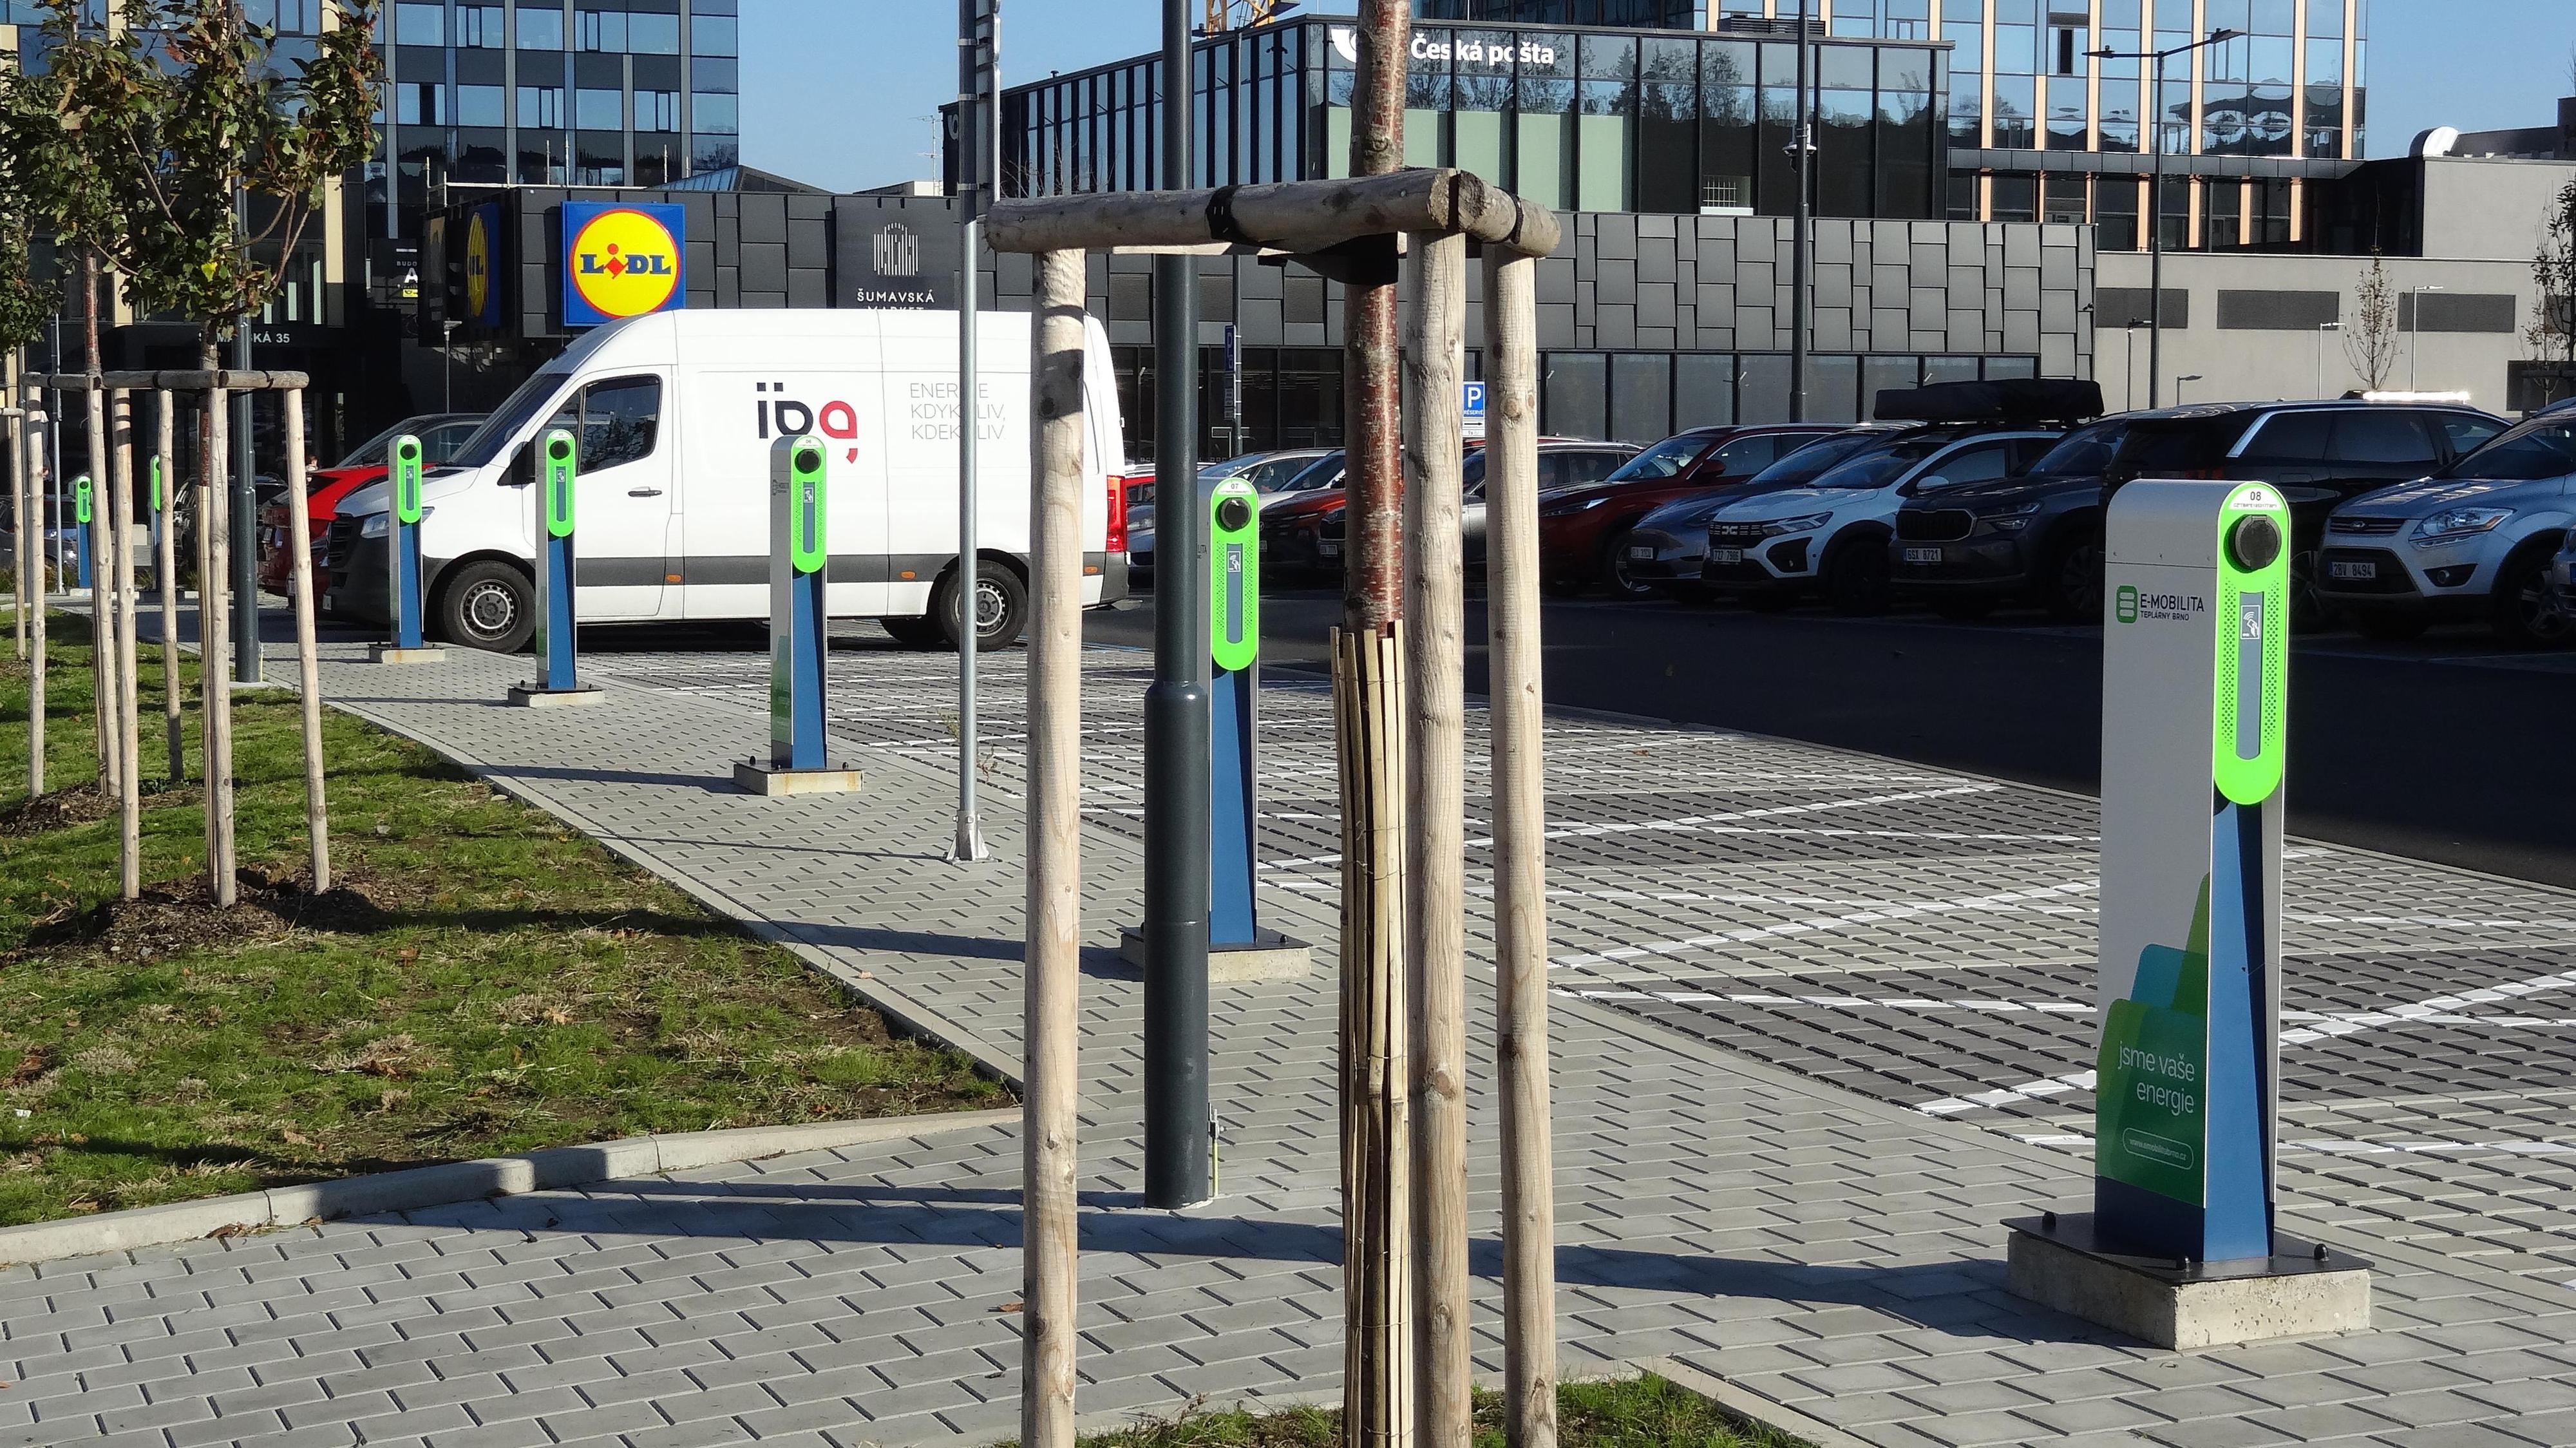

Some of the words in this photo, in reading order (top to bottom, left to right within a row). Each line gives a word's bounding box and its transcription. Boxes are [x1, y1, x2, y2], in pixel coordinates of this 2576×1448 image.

[1410, 33, 1482, 61] Česká
[1489, 41, 1554, 66] pošta
[580, 243, 671, 280] LIDL
[857, 288, 934, 303] ŠUMAVSKÁ
[276, 333, 290, 343] 35
[910, 383, 989, 398] ENERE
[1468, 387, 1481, 408] P
[911, 403, 1005, 421] KDYKLIV,
[2250, 491, 2261, 500] 08
[2353, 564, 2372, 577] 8494
[2140, 594, 2204, 612] E-MOBILITA
[2141, 610, 2170, 619] TEPLÁRNY
[2172, 613, 2189, 621] BRNO
[2117, 1040, 2155, 1072] jsme
[2159, 1053, 2195, 1082] vaše
[2137, 1081, 2195, 1116] energie
